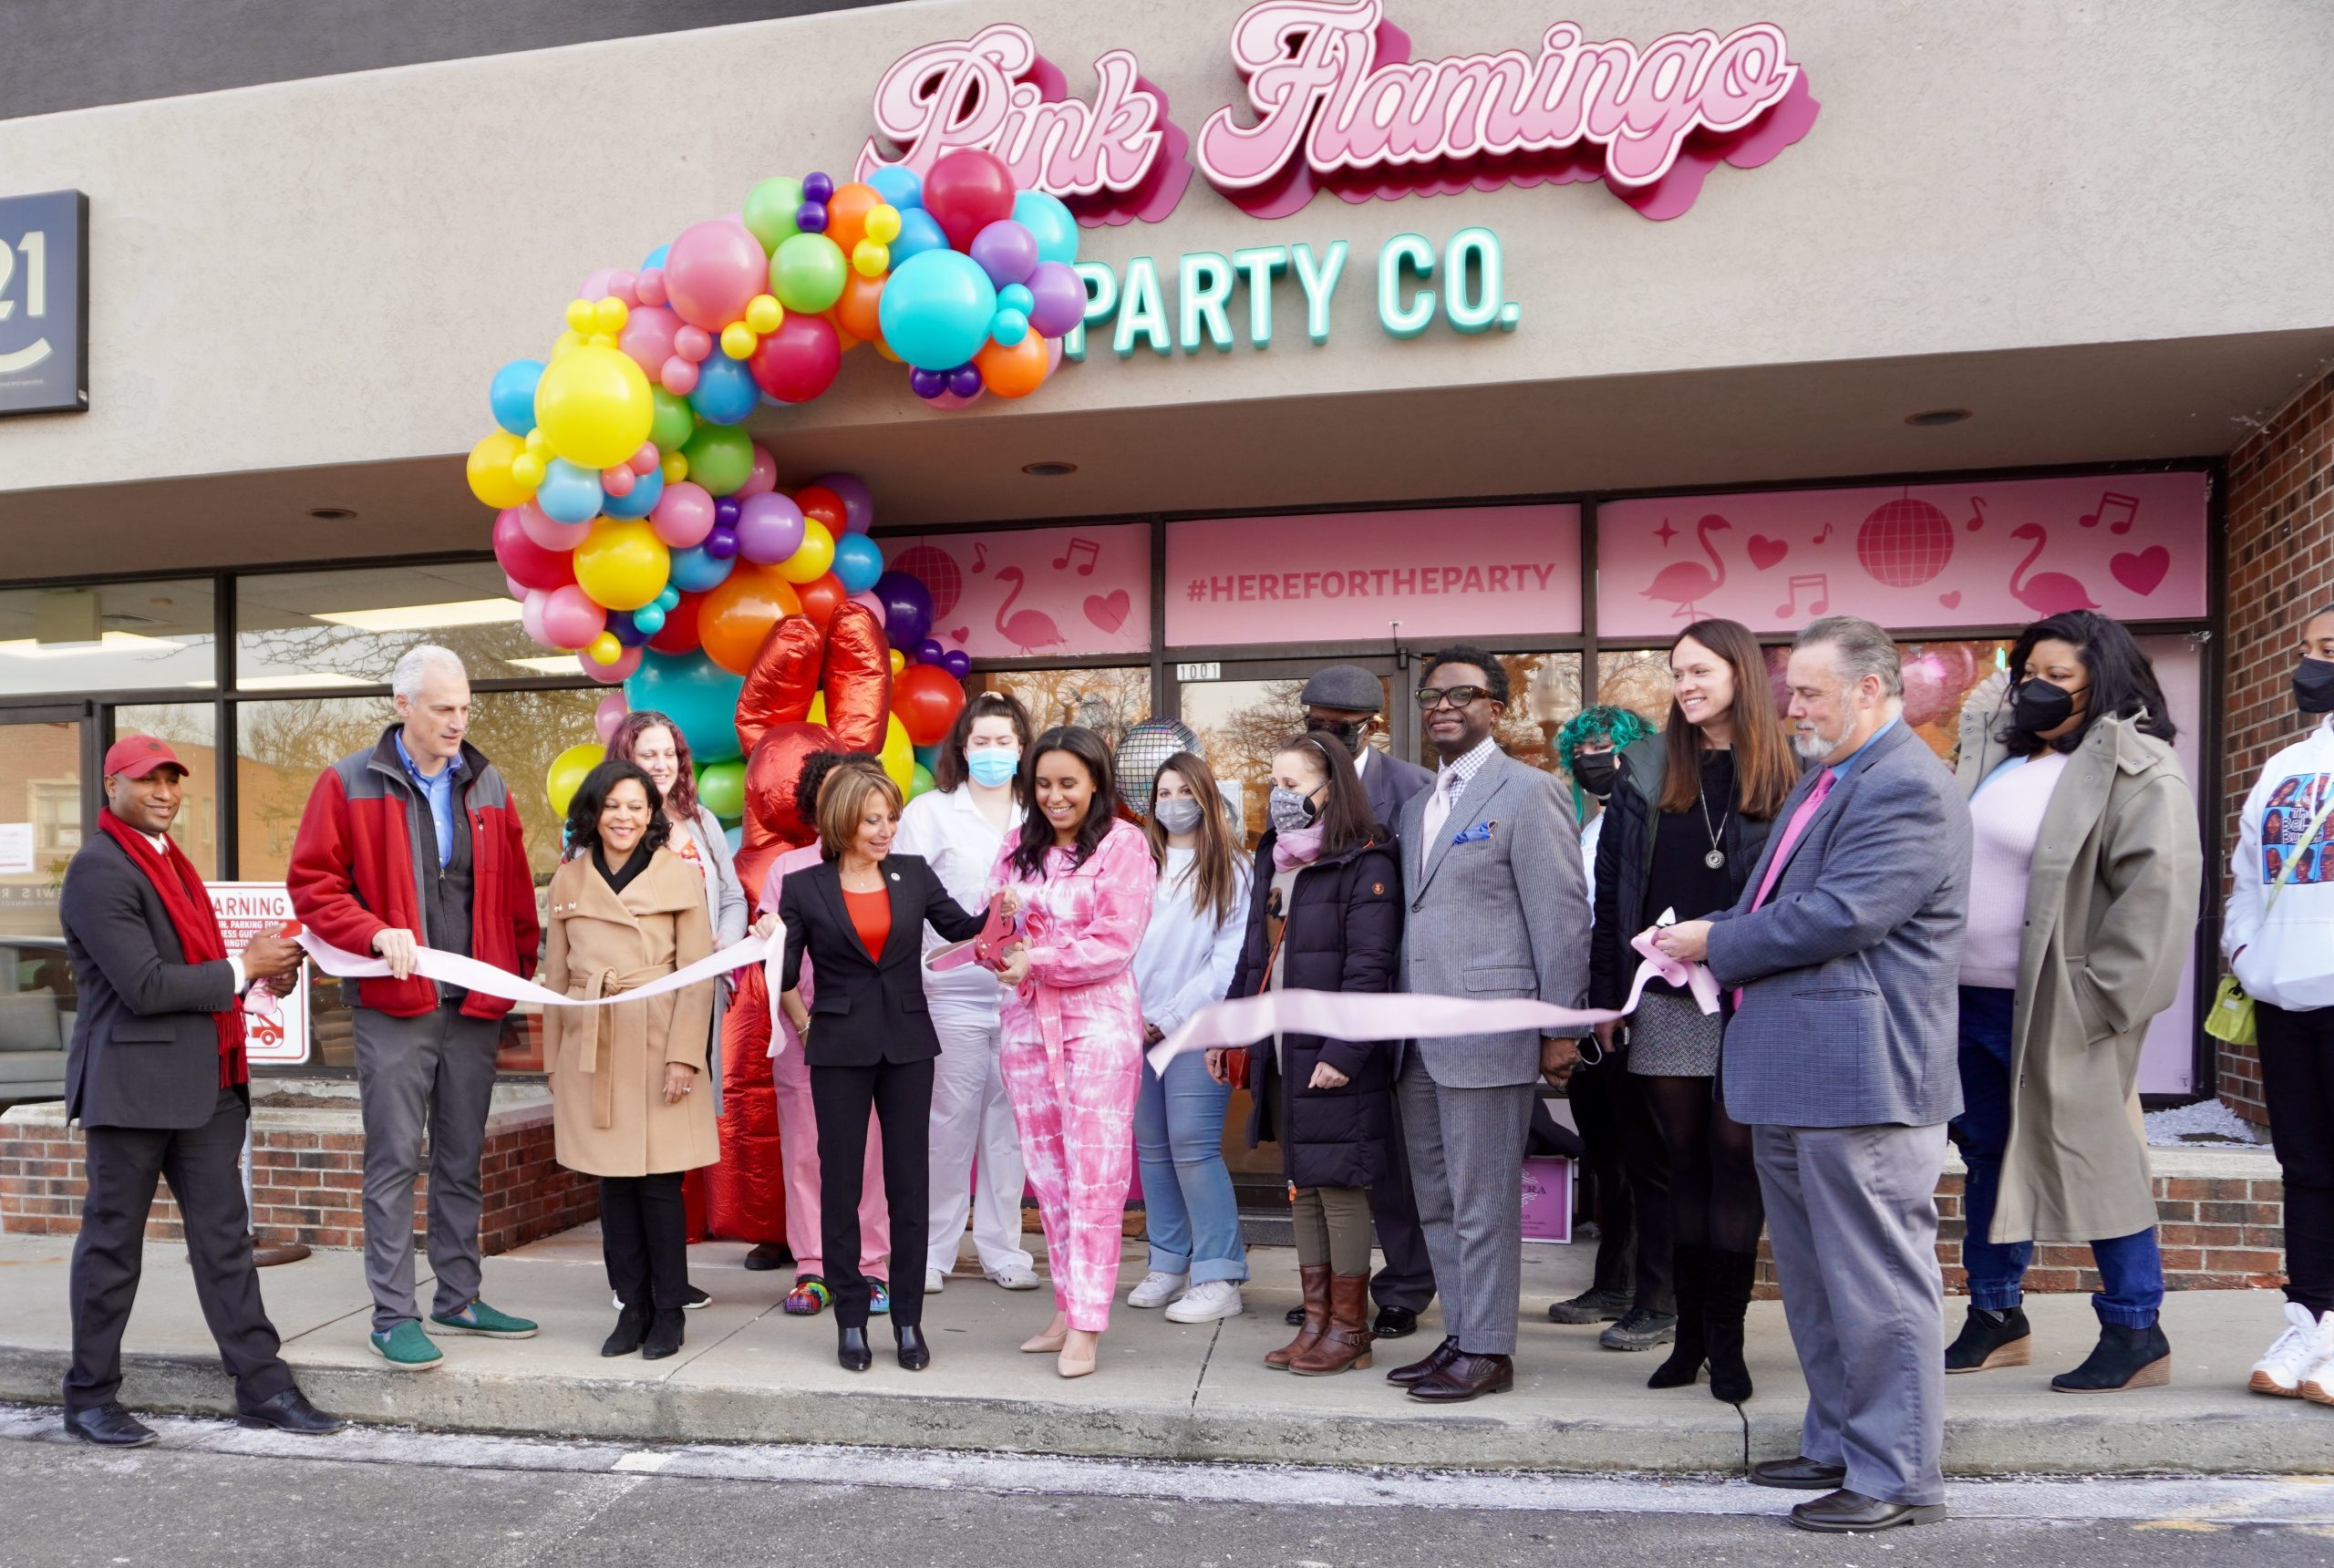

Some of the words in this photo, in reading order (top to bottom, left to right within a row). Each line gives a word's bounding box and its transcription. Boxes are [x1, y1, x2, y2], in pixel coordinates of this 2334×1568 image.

[853, 23, 1165, 199] Pink
[1197, 0, 1802, 186] Flamingo
[1064, 239, 1349, 362] PARTY
[1379, 226, 1521, 339] CO.
[1187, 562, 1555, 603] #HEREFORTHEPARTY
[1181, 663, 1217, 679] 1001
[213, 897, 284, 916] ARNING
[230, 920, 263, 929] PARKING
